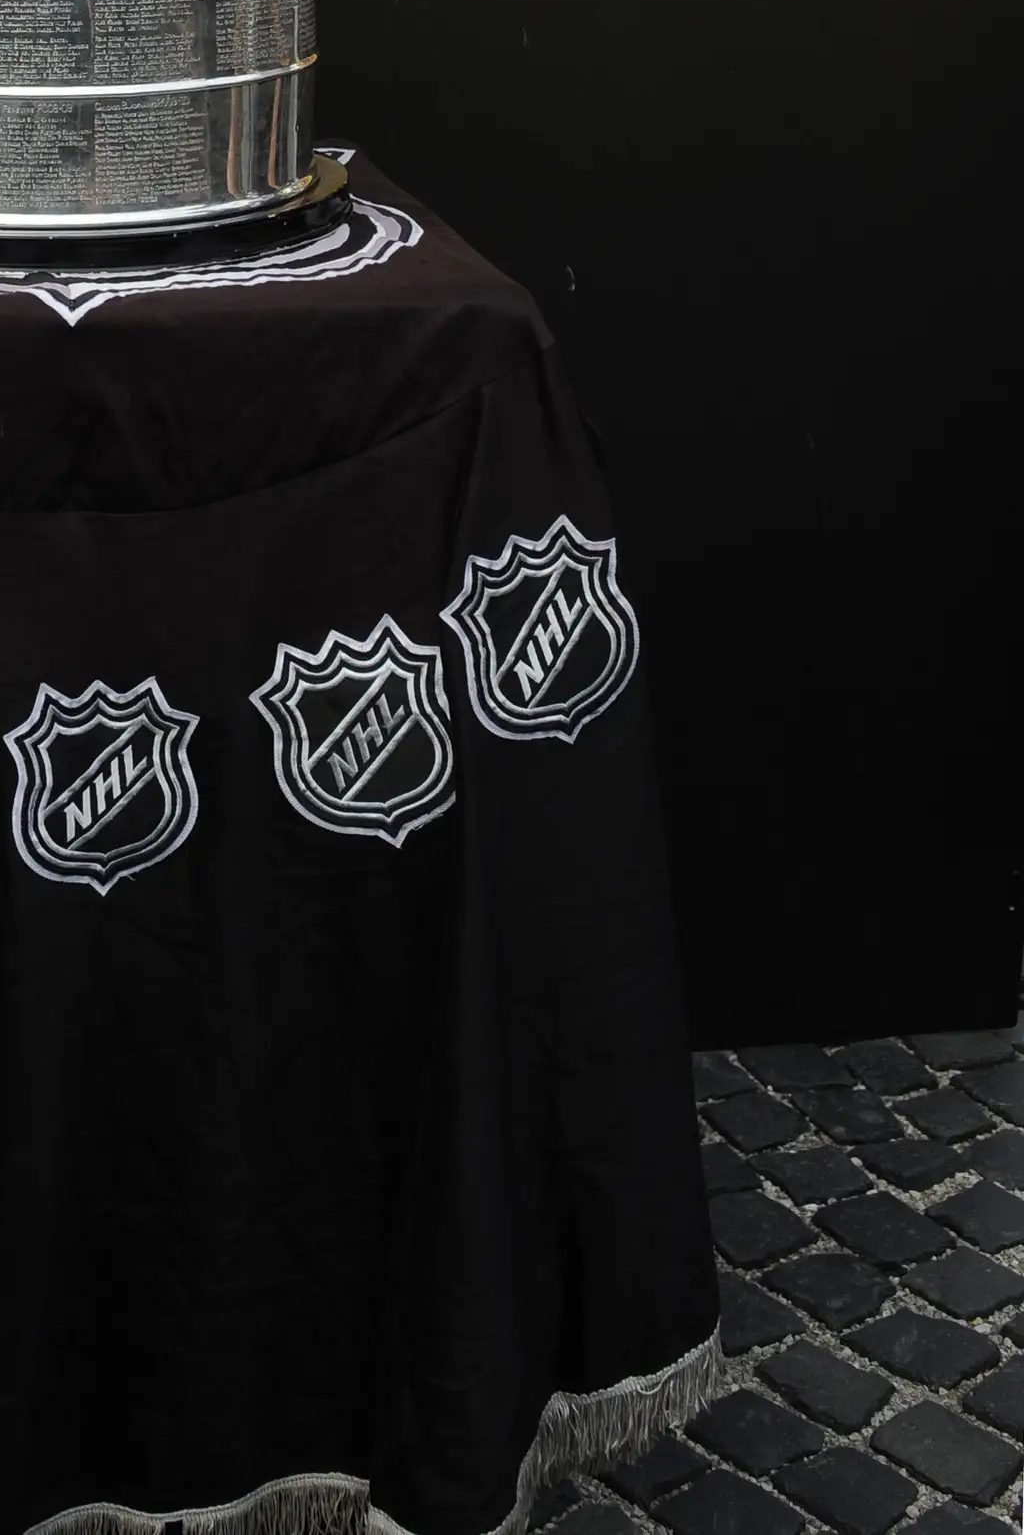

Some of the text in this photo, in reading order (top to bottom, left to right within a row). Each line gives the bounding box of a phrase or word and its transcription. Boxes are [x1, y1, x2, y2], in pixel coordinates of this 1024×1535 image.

[514, 587, 582, 702] NHL
[63, 743, 148, 842] NHL
[326, 692, 405, 794] NHL
